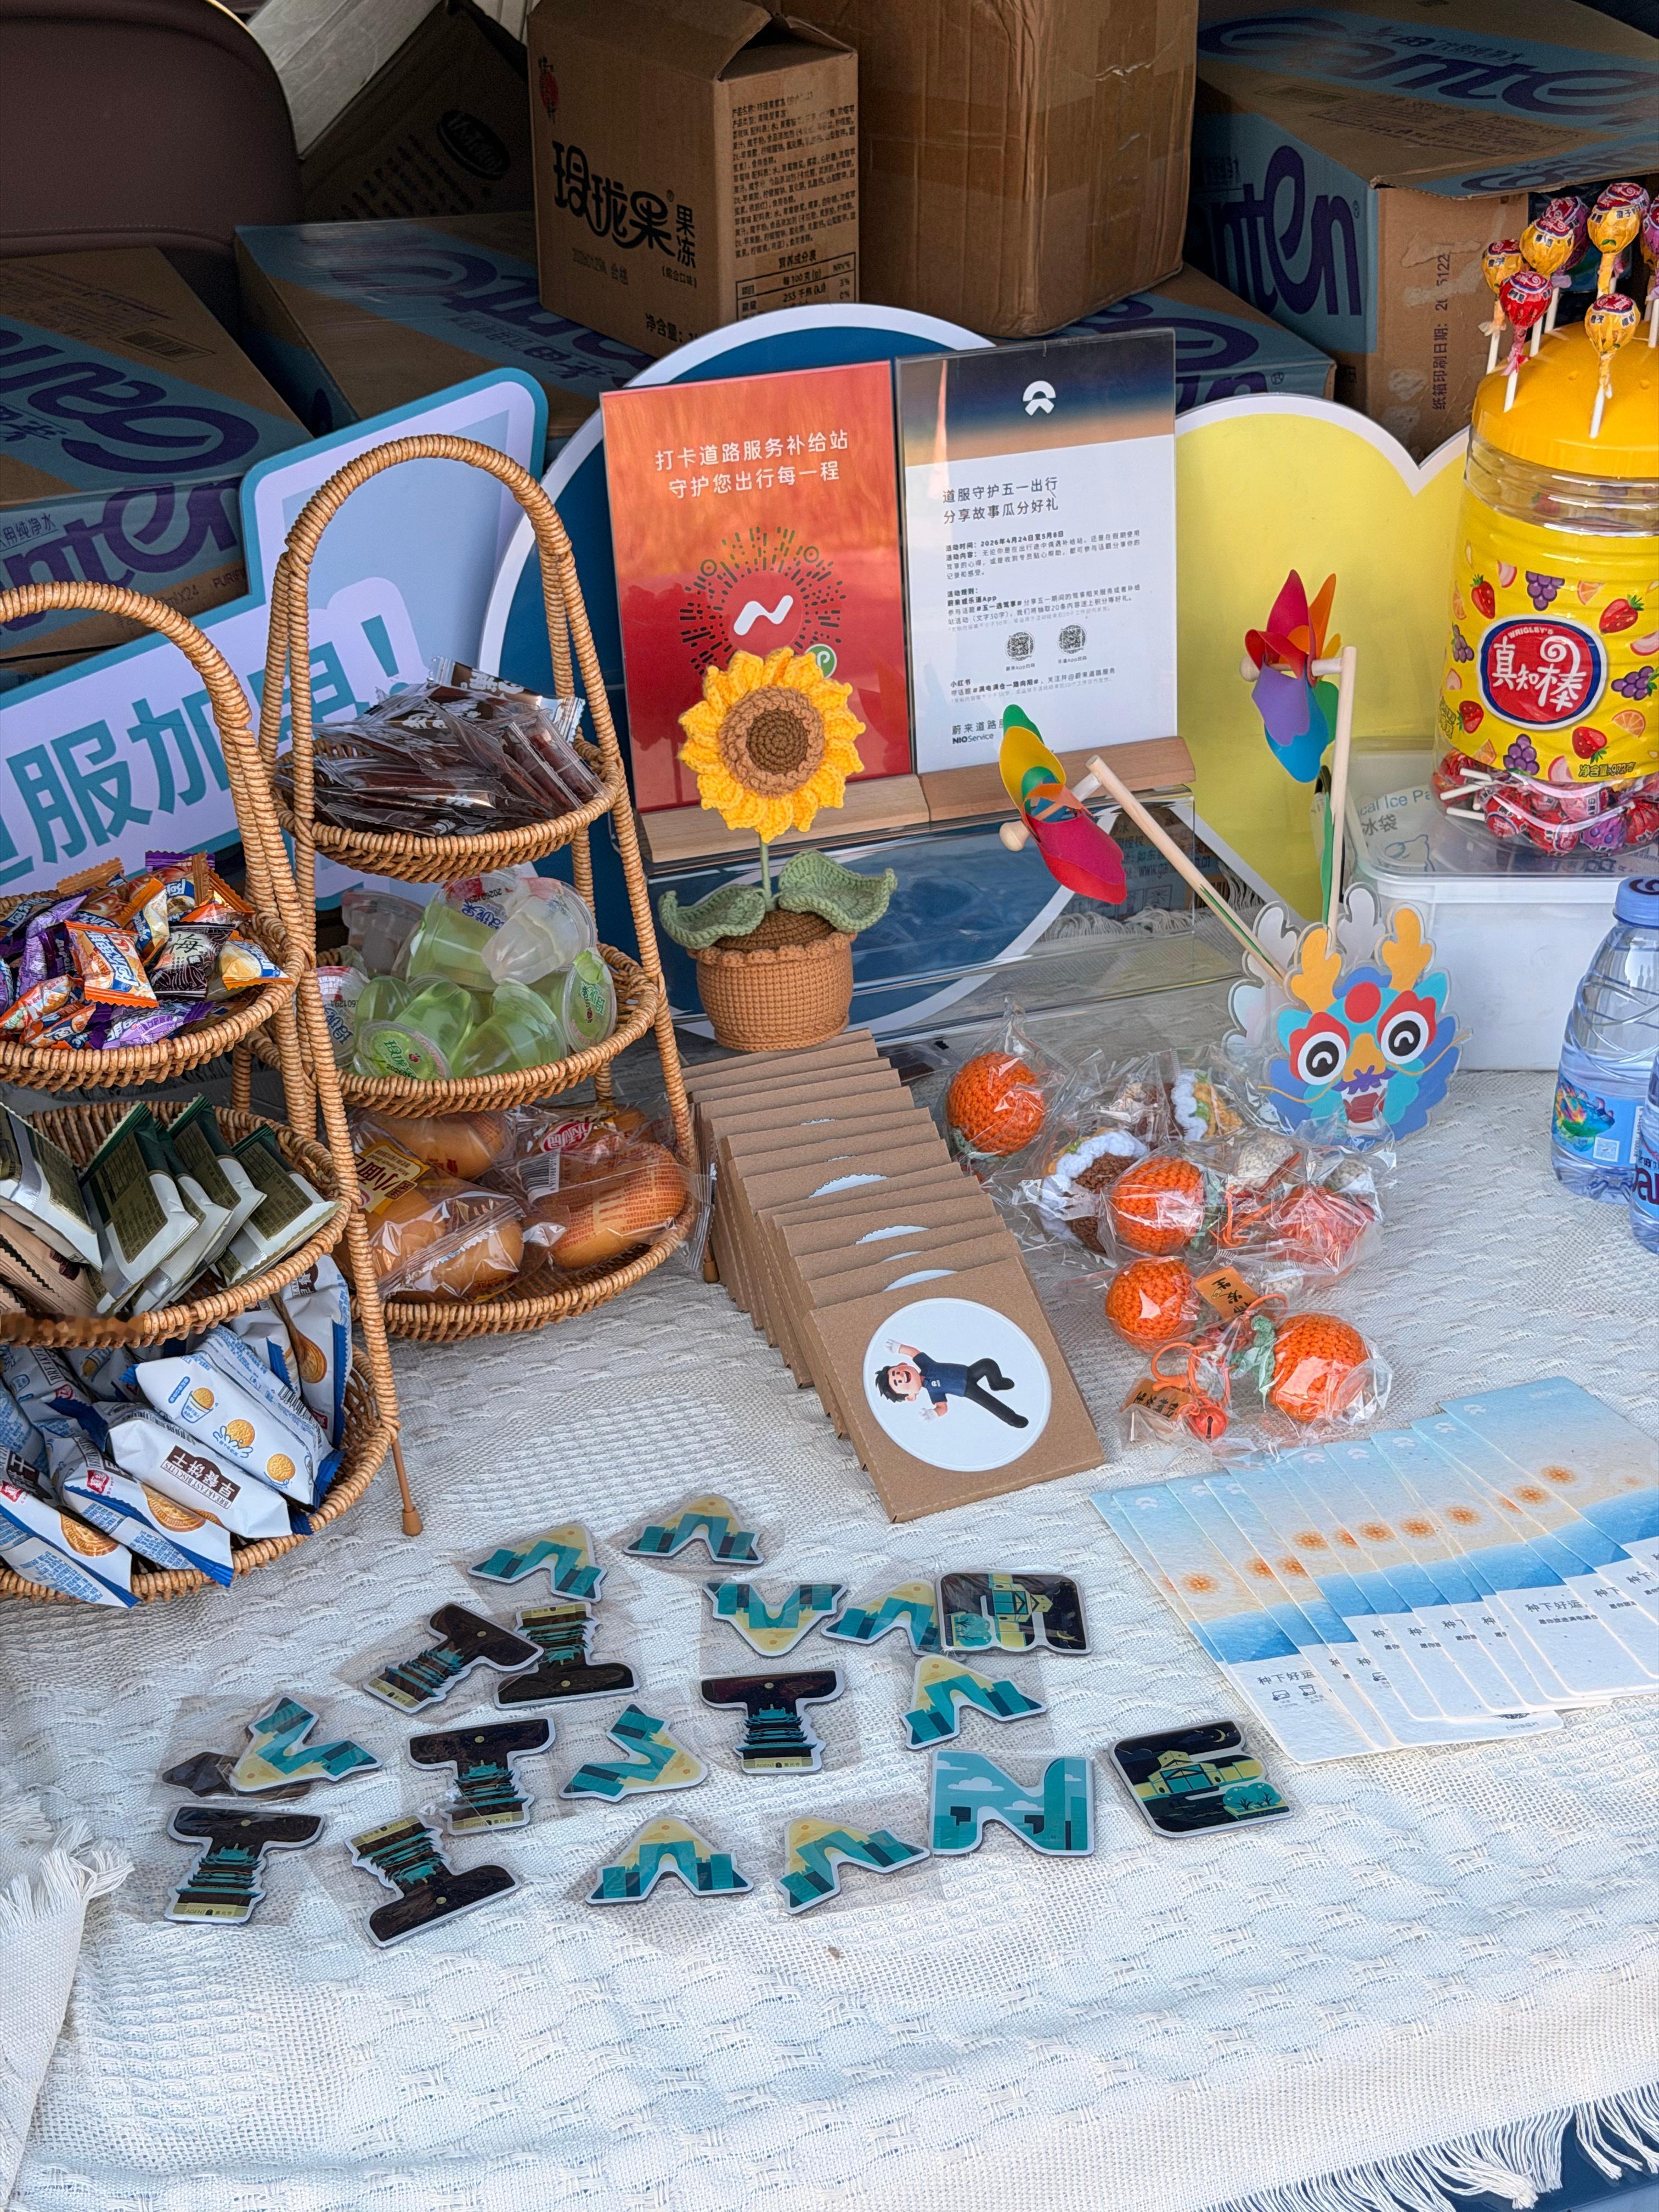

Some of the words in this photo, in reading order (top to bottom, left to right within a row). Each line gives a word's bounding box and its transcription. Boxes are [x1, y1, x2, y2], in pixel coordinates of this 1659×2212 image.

[552, 140, 676, 258] 玲珑果
[675, 205, 697, 269] 果冻
[655, 430, 848, 471] 打卡道路服务补给站
[669, 461, 840, 499] 守护您出行每一程
[943, 477, 1058, 504] 道服守护五一出行
[943, 498, 1059, 524] 分享故事瓜分好礼
[0, 512, 55, 547] 用纯净水
[1508, 626, 1554, 639] WRIGLEY'S
[951, 679, 971, 688] 小红书
[1492, 635, 1587, 712] 真知棒
[1384, 794, 1407, 809] Ice
[162, 1462, 195, 1486] BISCUITS
[171, 1452, 237, 1498] 早餐饼干
[193, 1480, 231, 1509] BREAKFAST
[1257, 1669, 1316, 1686] 种下好运
